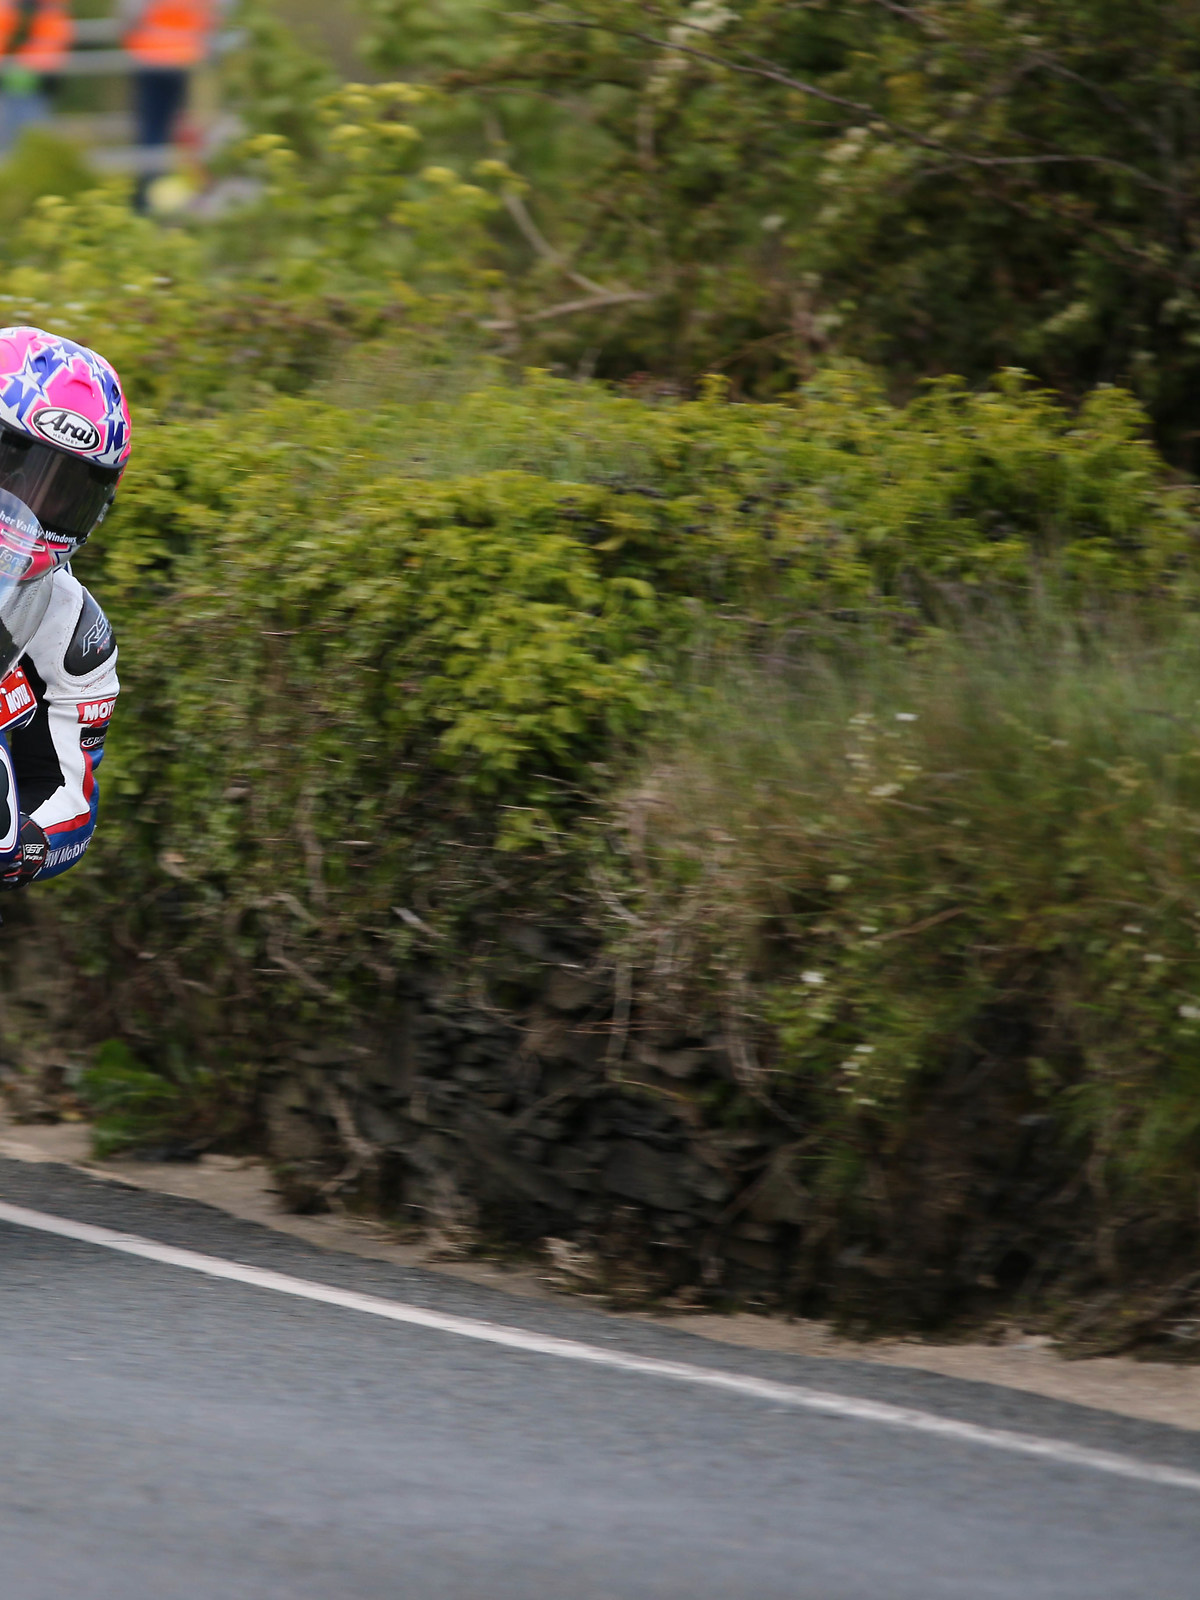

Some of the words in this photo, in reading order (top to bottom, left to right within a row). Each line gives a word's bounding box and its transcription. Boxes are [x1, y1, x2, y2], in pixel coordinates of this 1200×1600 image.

[36, 412, 94, 444] Arai
[15, 519, 44, 538] Valley
[44, 530, 78, 545] Windows
[5, 682, 31, 715] MOTUL
